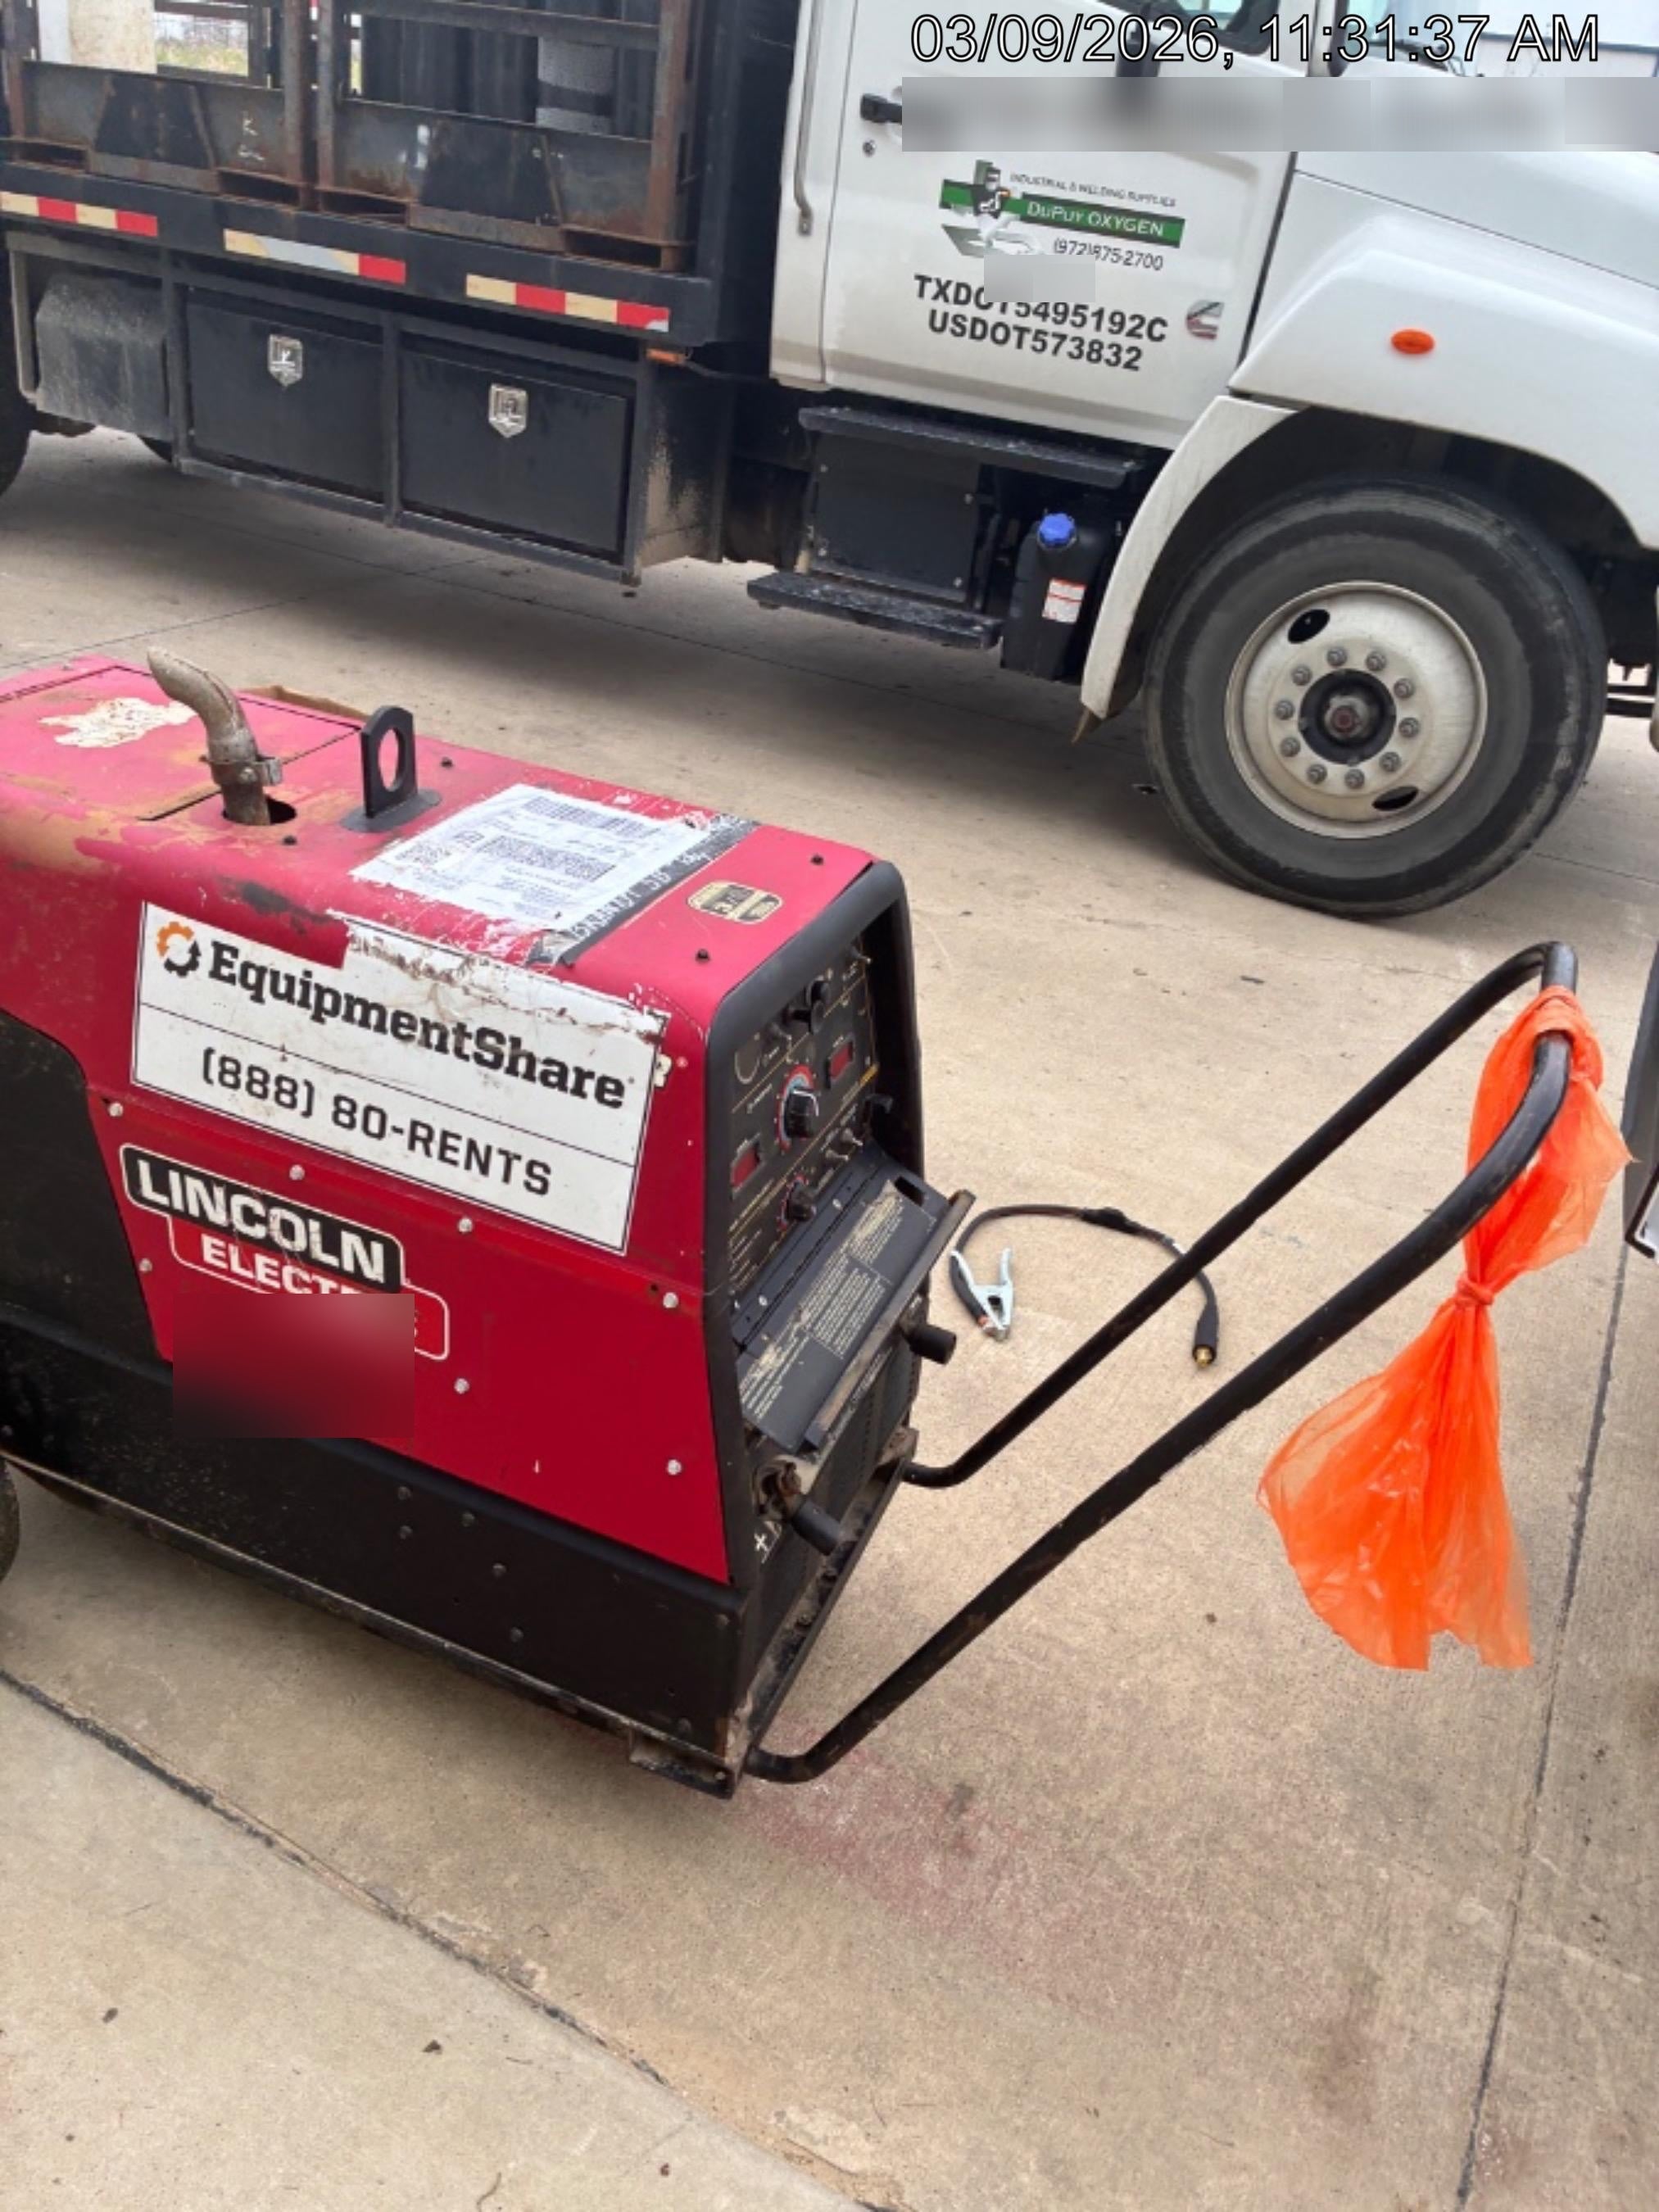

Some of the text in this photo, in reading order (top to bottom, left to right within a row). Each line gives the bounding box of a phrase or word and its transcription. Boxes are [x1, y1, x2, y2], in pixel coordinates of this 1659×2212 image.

[1088, 210, 1165, 237] OXYGEN
[928, 308, 1144, 371] USDOT573832
[209, 939, 628, 1109] EquipmentShare
[202, 1045, 553, 1197] (888) 80-RENTS
[136, 1158, 385, 1285] LINCOLN
